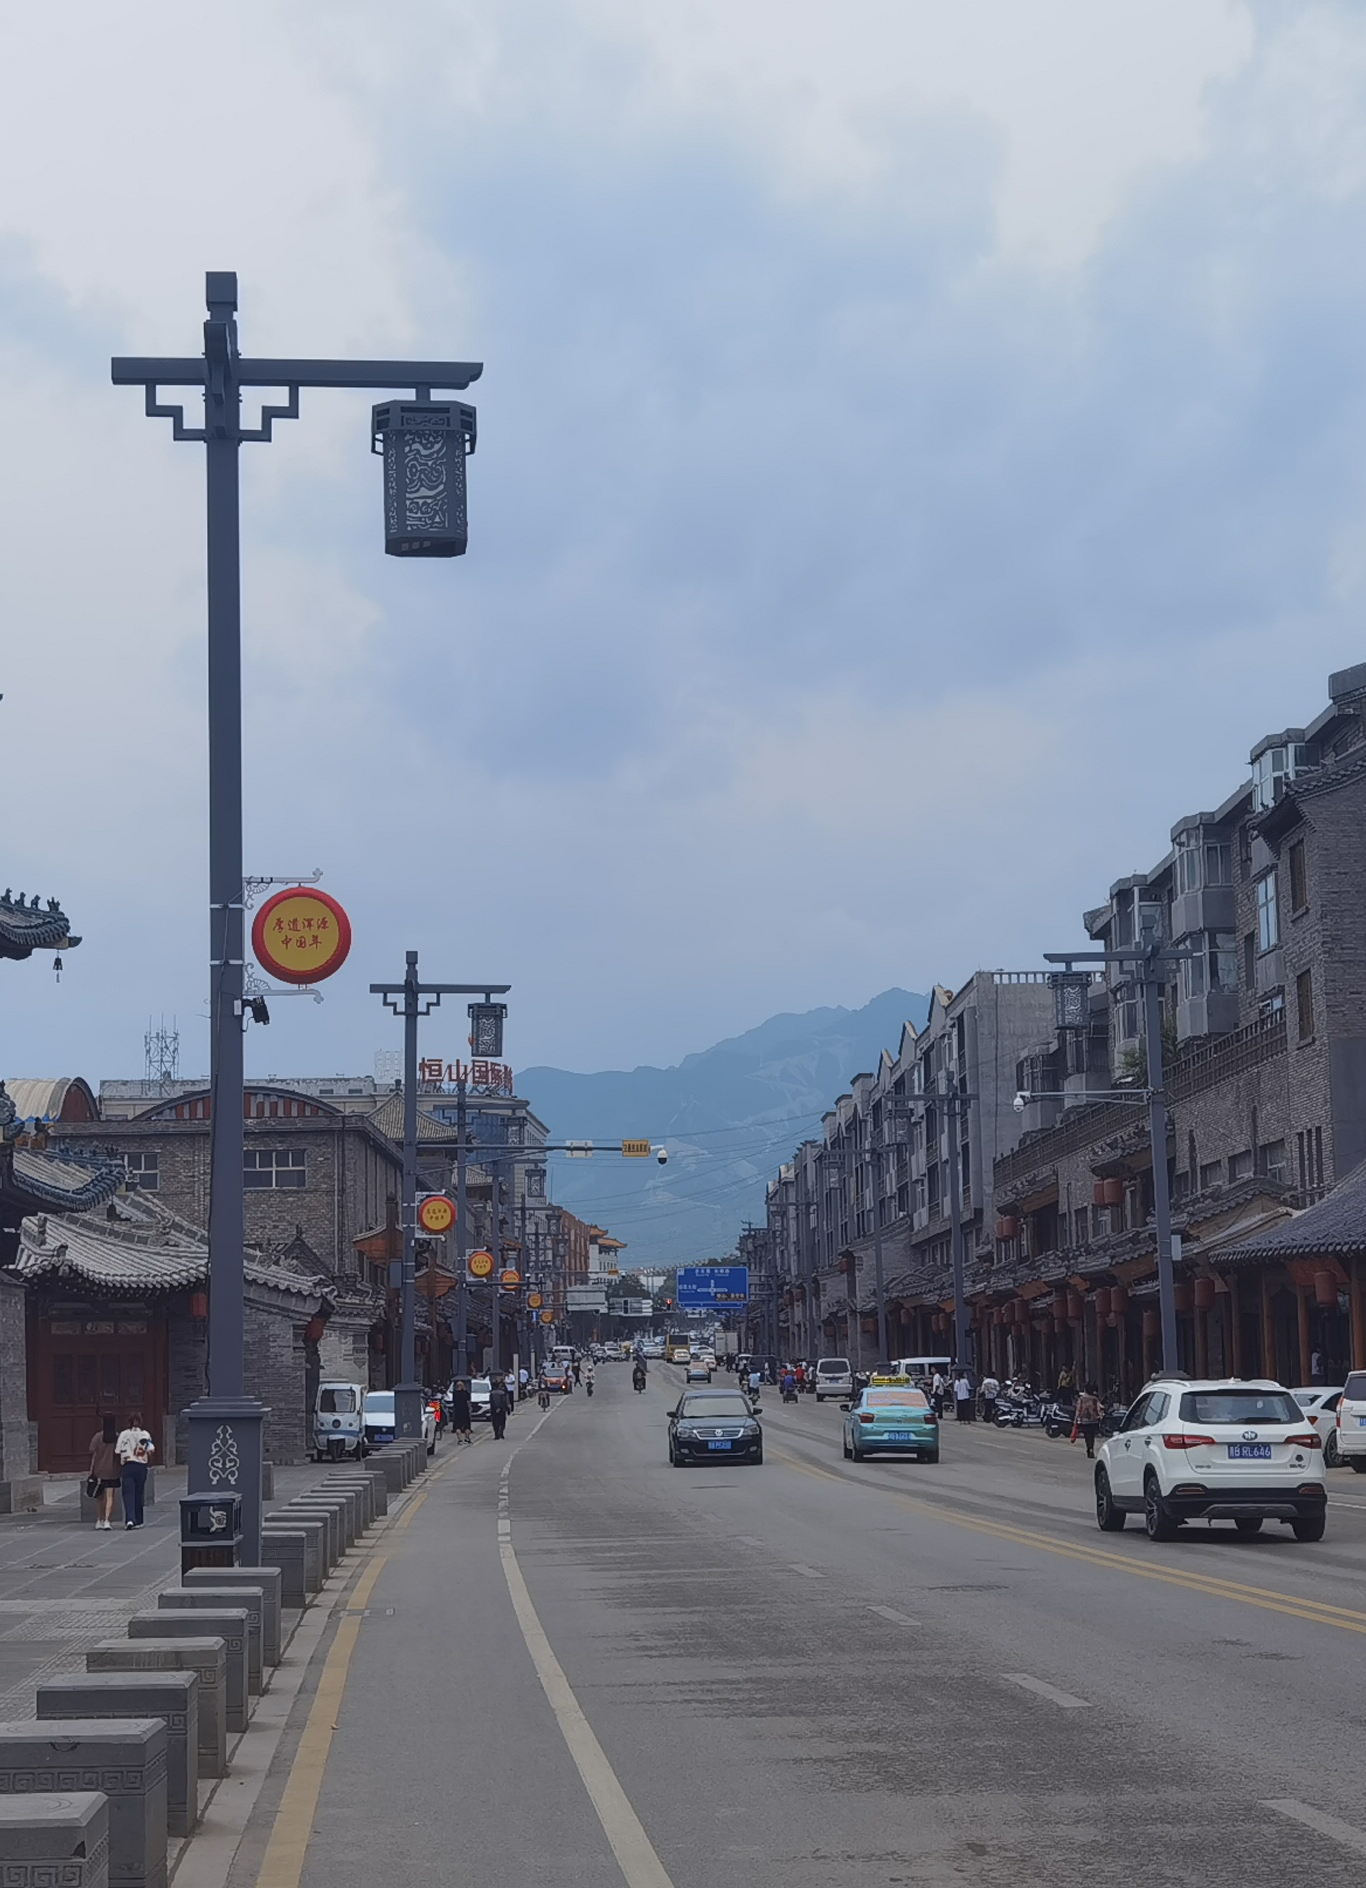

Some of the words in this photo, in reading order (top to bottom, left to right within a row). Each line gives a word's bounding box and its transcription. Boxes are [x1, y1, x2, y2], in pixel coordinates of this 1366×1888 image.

[272, 916, 330, 934] 厚道浑源
[280, 934, 323, 950] 中国年
